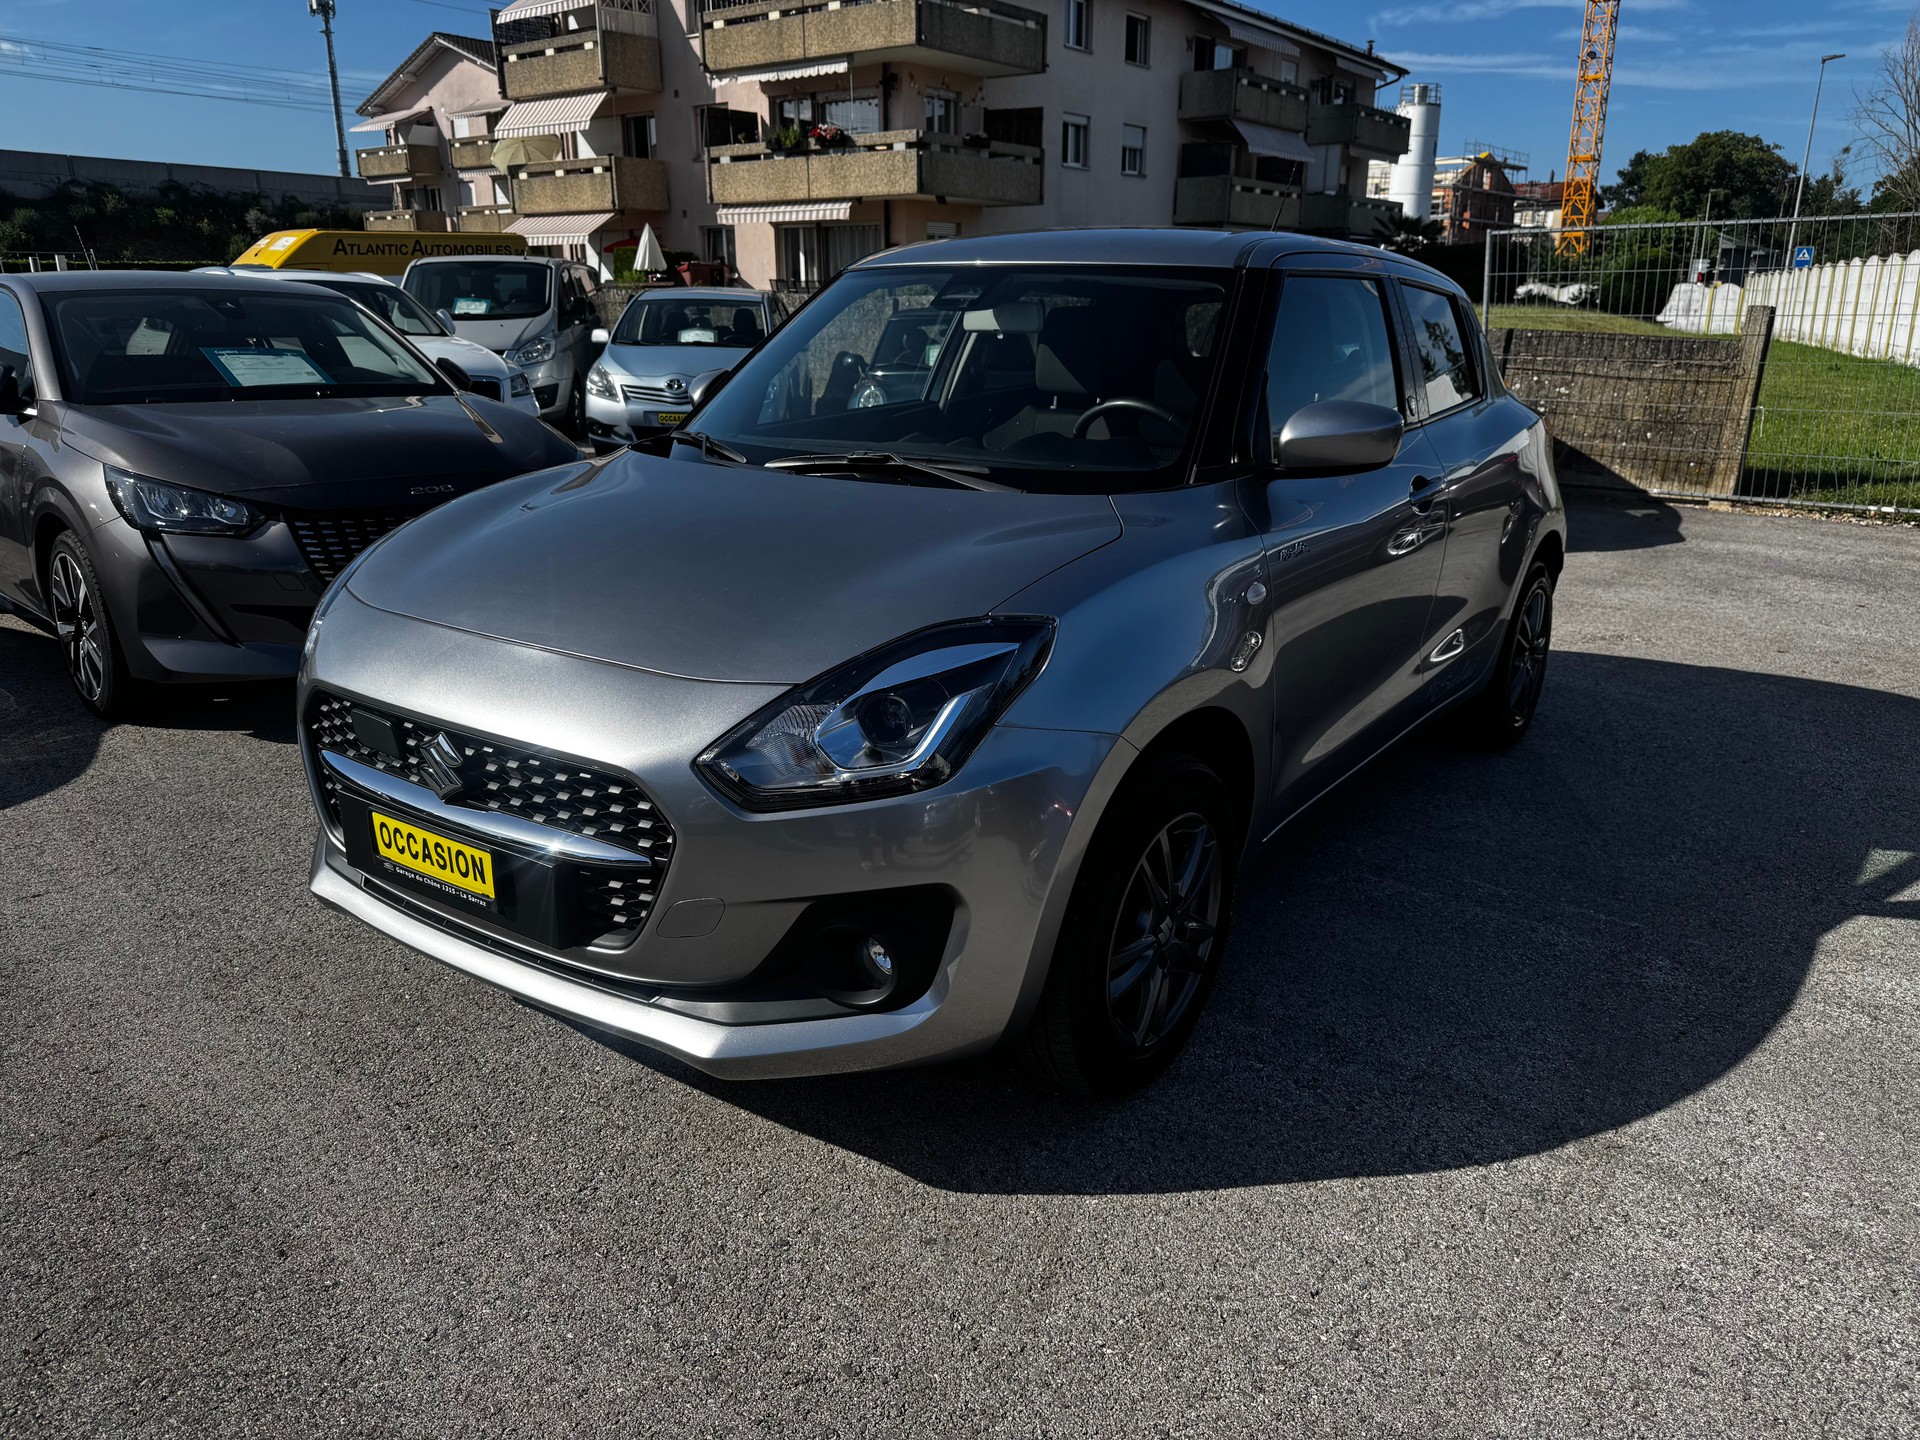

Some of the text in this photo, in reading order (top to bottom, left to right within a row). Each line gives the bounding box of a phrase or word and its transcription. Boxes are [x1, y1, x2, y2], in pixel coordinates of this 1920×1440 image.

[333, 238, 409, 256] ATLANTIC
[411, 239, 512, 256] AUTOMOBILES
[411, 485, 454, 494] 208
[379, 821, 486, 885] OCCASION
[395, 866, 415, 879] Garage
[416, 874, 423, 882] du
[424, 877, 441, 889] Chêne
[442, 884, 455, 895] 1315
[468, 896, 487, 907] Sarraz
